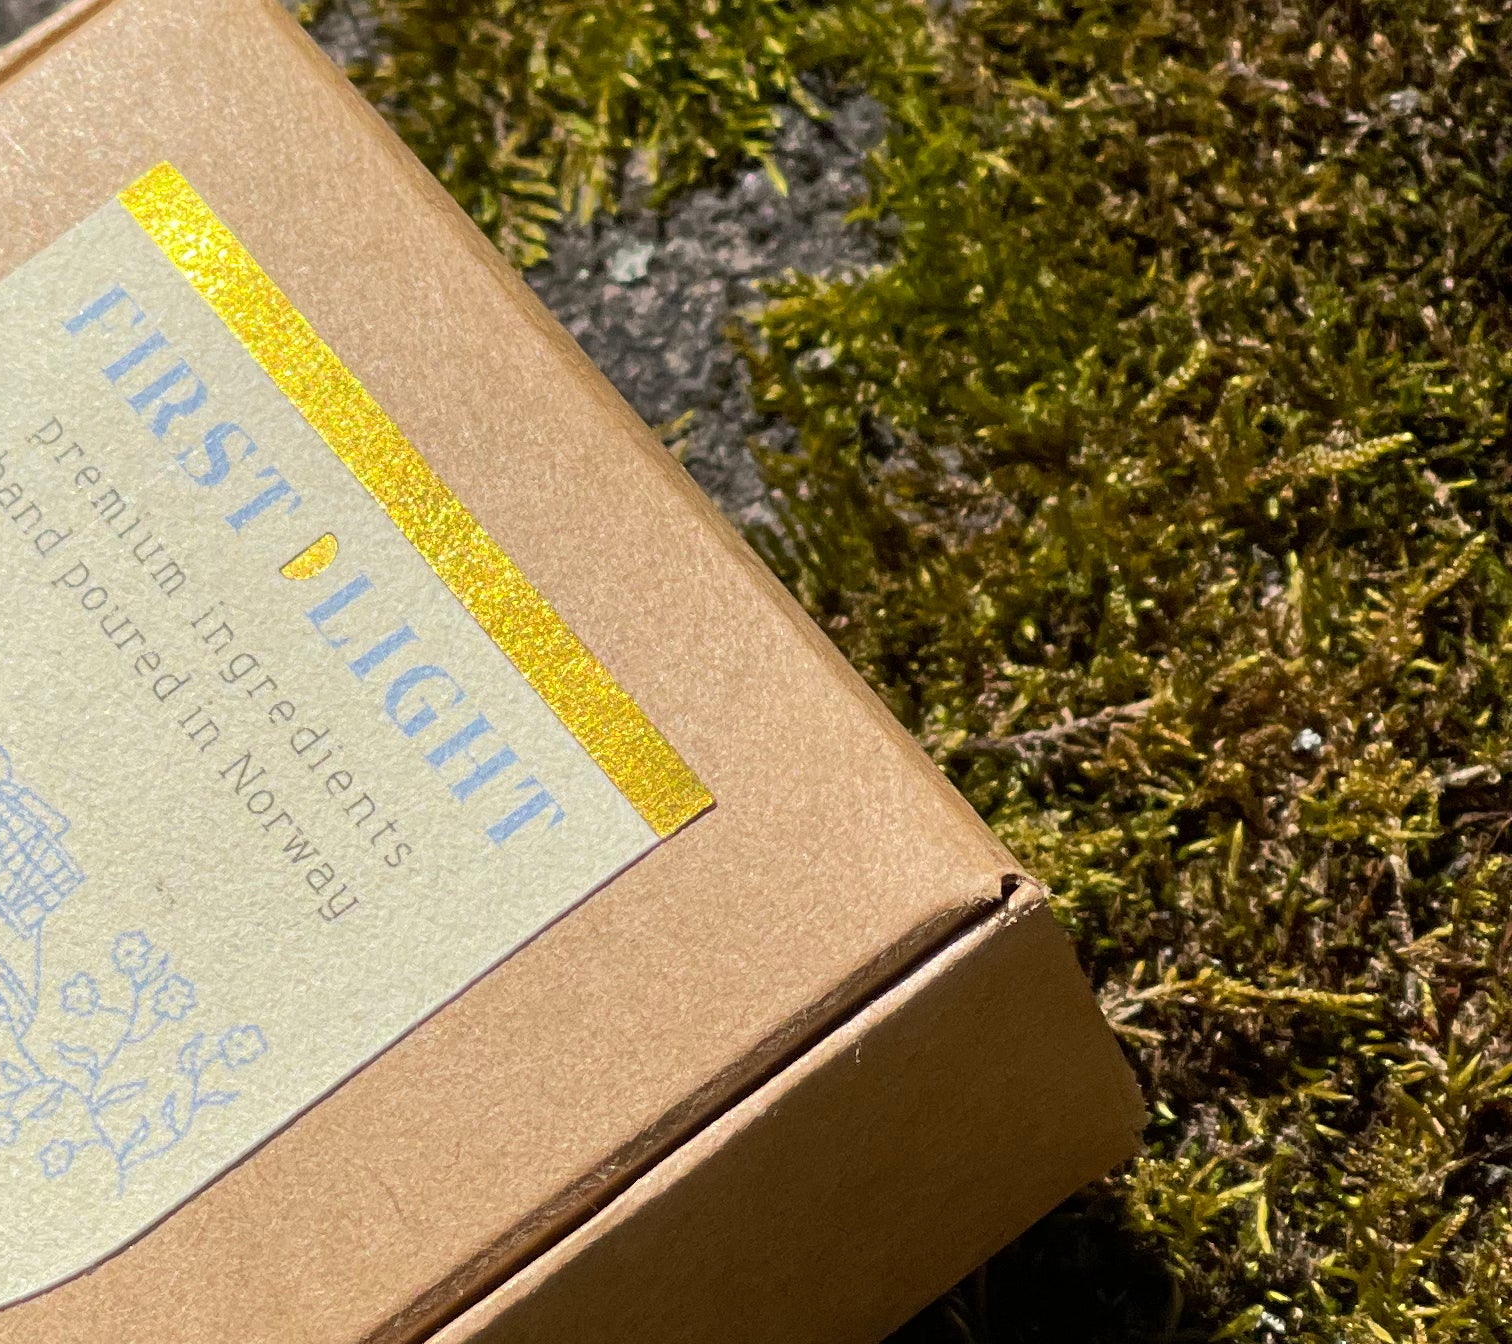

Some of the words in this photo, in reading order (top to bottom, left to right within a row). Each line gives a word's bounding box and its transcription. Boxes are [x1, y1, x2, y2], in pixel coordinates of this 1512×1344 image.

[27, 416, 188, 598] premium
[189, 600, 413, 869] ingredients
[52, 557, 189, 703] poured
[179, 703, 221, 754] in
[219, 751, 361, 922] Norway
[62, 283, 303, 533] FIRST
[304, 572, 566, 846] LIGHT
